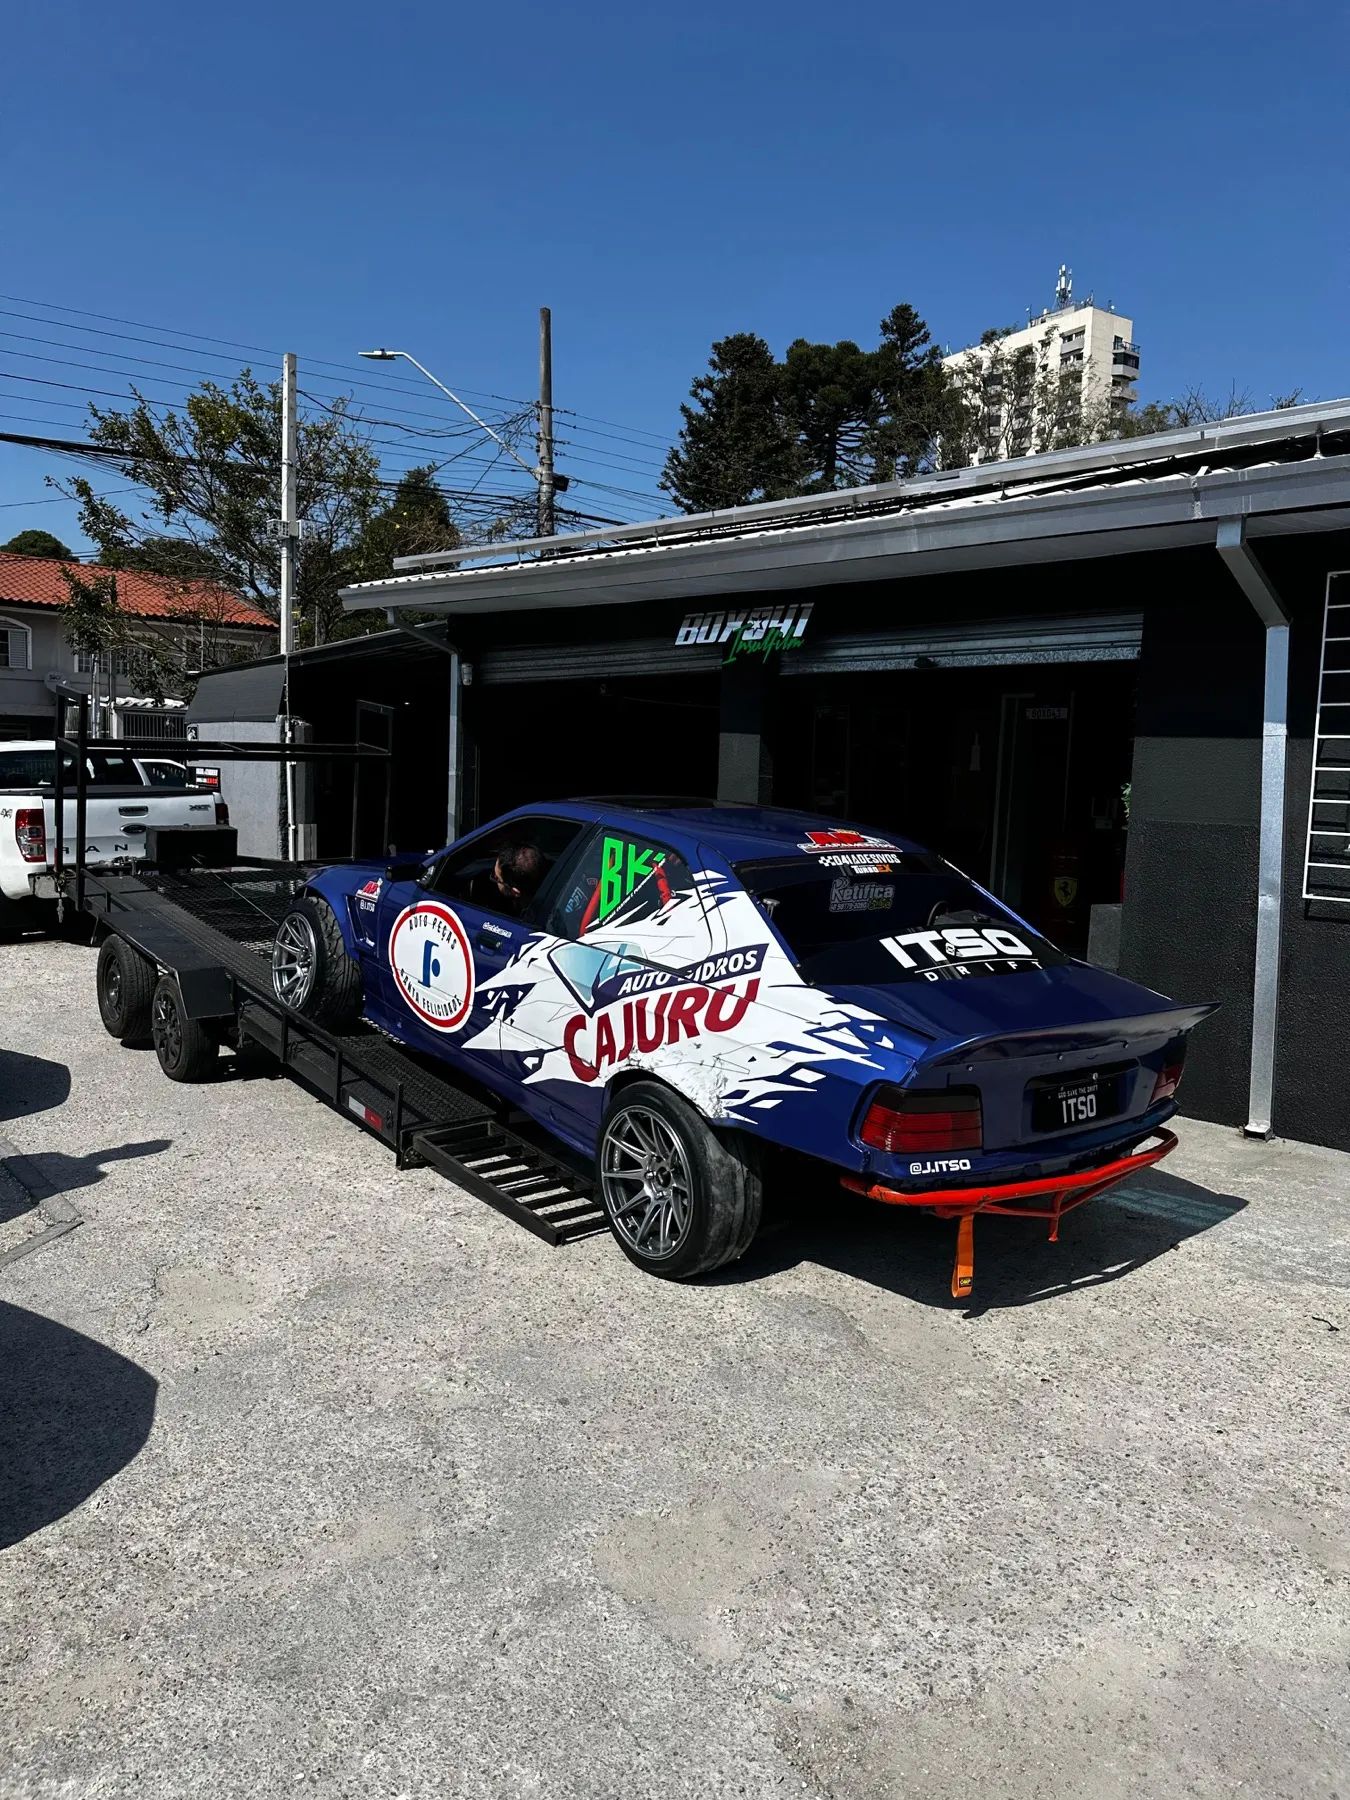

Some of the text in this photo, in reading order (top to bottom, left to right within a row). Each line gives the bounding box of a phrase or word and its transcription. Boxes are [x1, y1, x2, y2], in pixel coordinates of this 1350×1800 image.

[722, 622, 805, 664] Insulfilm
[831, 878, 894, 901] Retifica
[408, 914, 428, 932] AUTO
[432, 915, 457, 951] PEÇAS
[879, 928, 1033, 969] ITSO
[617, 972, 672, 996] AUTO
[924, 960, 1044, 982] DRIFT
[400, 967, 462, 1017] SANTA FELICIDADE
[563, 977, 761, 1083] CAJURU
[1062, 1094, 1097, 1124] ITSO
[910, 1158, 971, 1175] @J.ITSO
